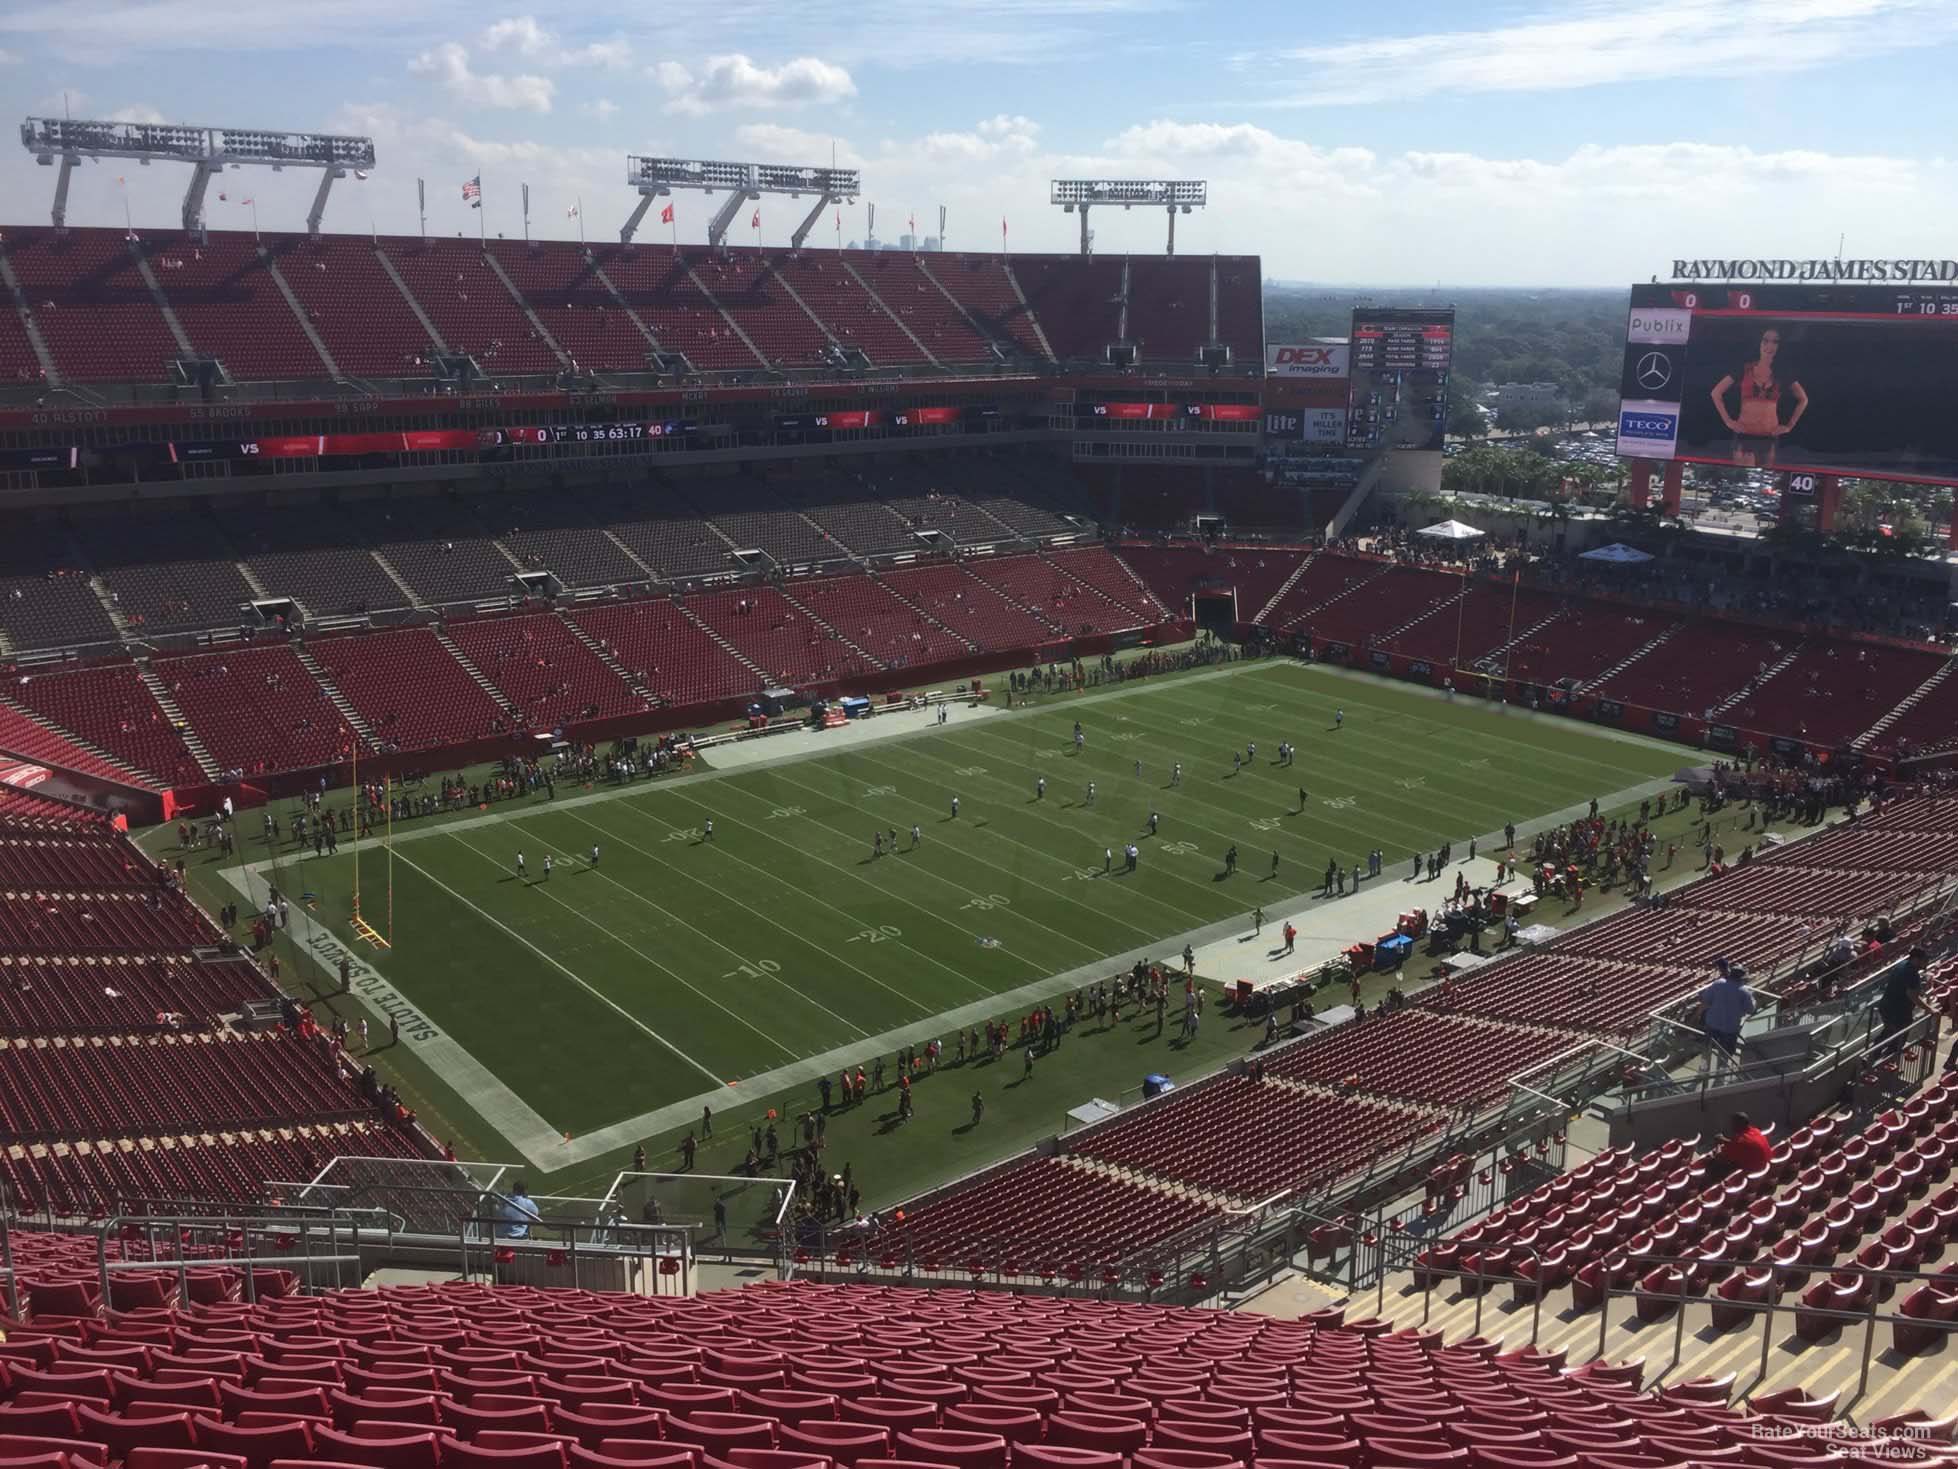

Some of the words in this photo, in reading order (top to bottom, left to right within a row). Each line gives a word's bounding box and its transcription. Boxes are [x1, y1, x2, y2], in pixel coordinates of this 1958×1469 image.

[1672, 259, 1795, 279] RAYMOND
[1799, 260, 1888, 281] JAMES
[1685, 294, 1697, 308] 0
[1739, 294, 1751, 308] 0
[1920, 303, 1936, 314] 10
[1275, 347, 1336, 364] DEX
[1288, 364, 1340, 374] imaging
[1094, 406, 1107, 414] VS
[1187, 406, 1200, 414] VS
[815, 416, 828, 426] VS
[895, 416, 908, 425] VS
[1265, 414, 1297, 433] Lite
[1626, 418, 1669, 431] TECO
[575, 431, 588, 440] 10
[593, 430, 606, 440] 35
[608, 427, 642, 439] 63:17
[648, 425, 662, 435] 40
[240, 443, 260, 455] VS
[1790, 475, 1814, 491] 40
[859, 925, 902, 943] 20
[738, 960, 781, 978] 10
[355, 977, 388, 996] TO
[374, 992, 440, 1042] SALUTE
